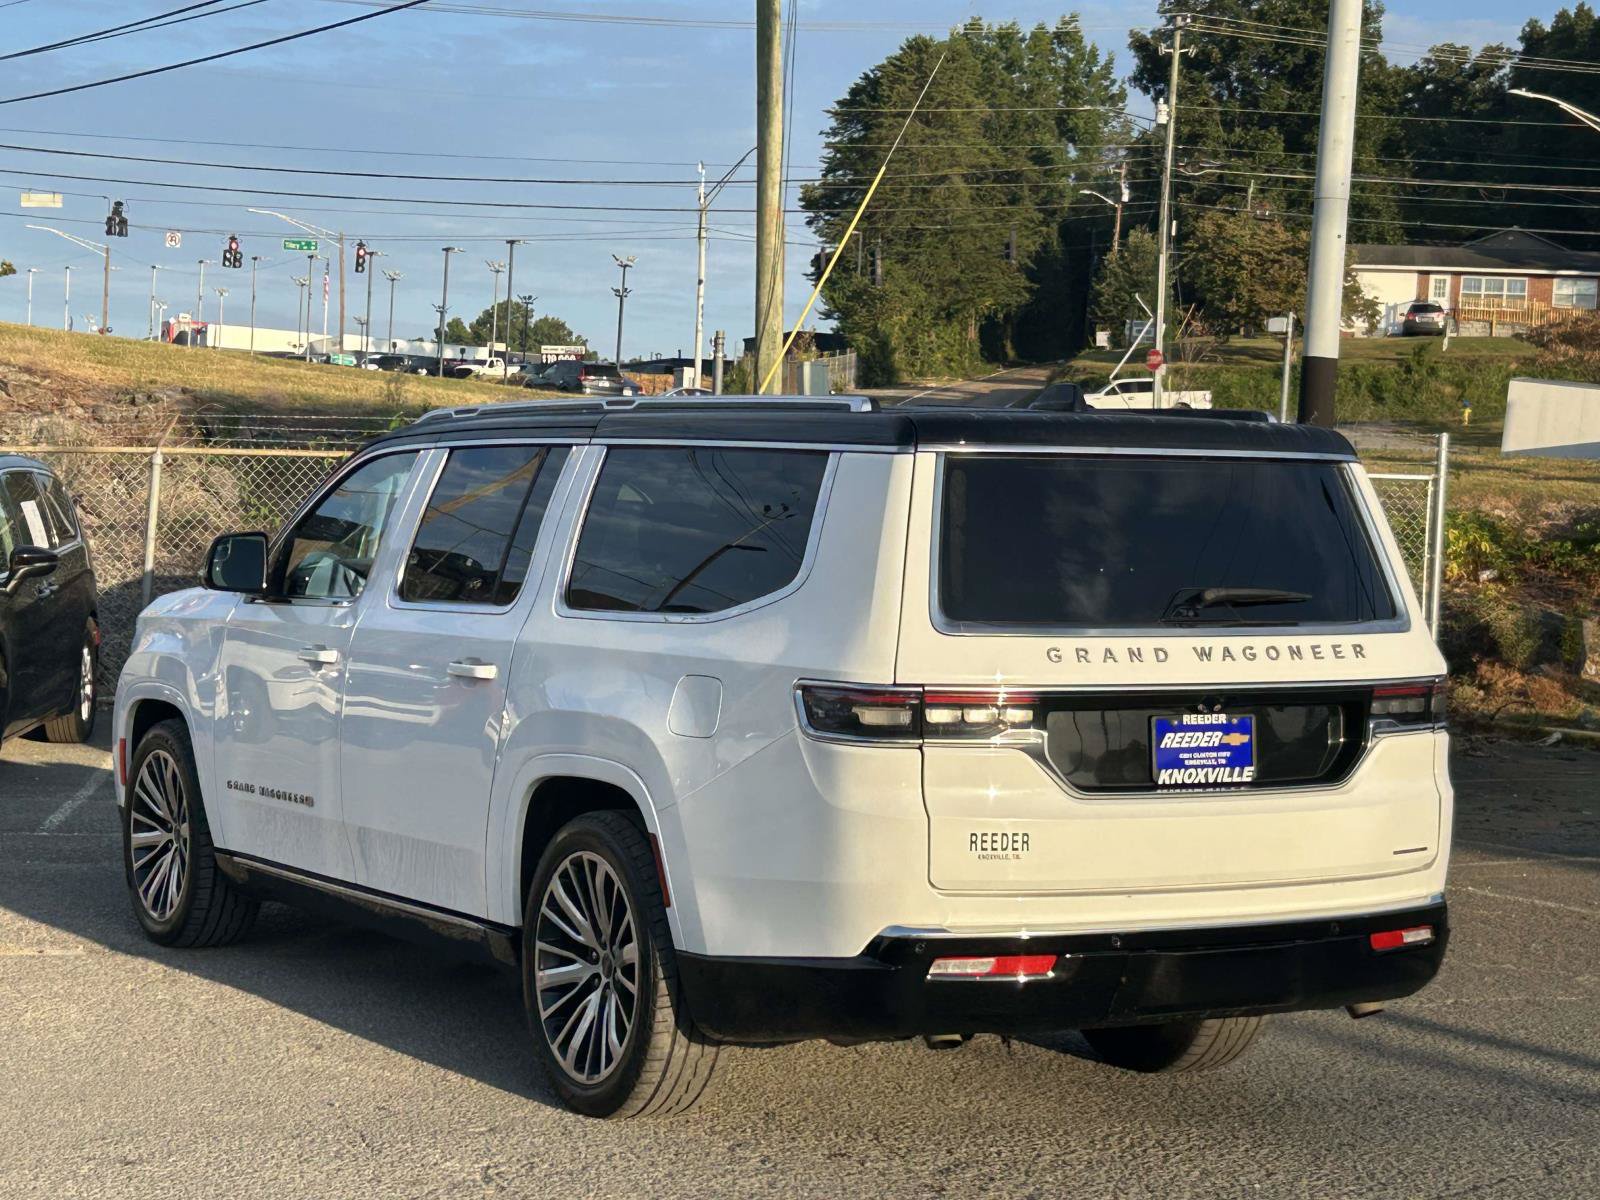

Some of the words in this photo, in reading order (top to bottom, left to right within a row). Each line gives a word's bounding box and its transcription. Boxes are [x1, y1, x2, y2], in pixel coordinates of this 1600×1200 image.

[1046, 647, 1169, 663] GRAND
[1192, 643, 1366, 662] WAGONEER
[1182, 713, 1227, 725] REEDER
[1160, 731, 1223, 748] REEDER
[1158, 766, 1255, 785] KNOXVILLE
[969, 832, 1030, 852] REEDER
